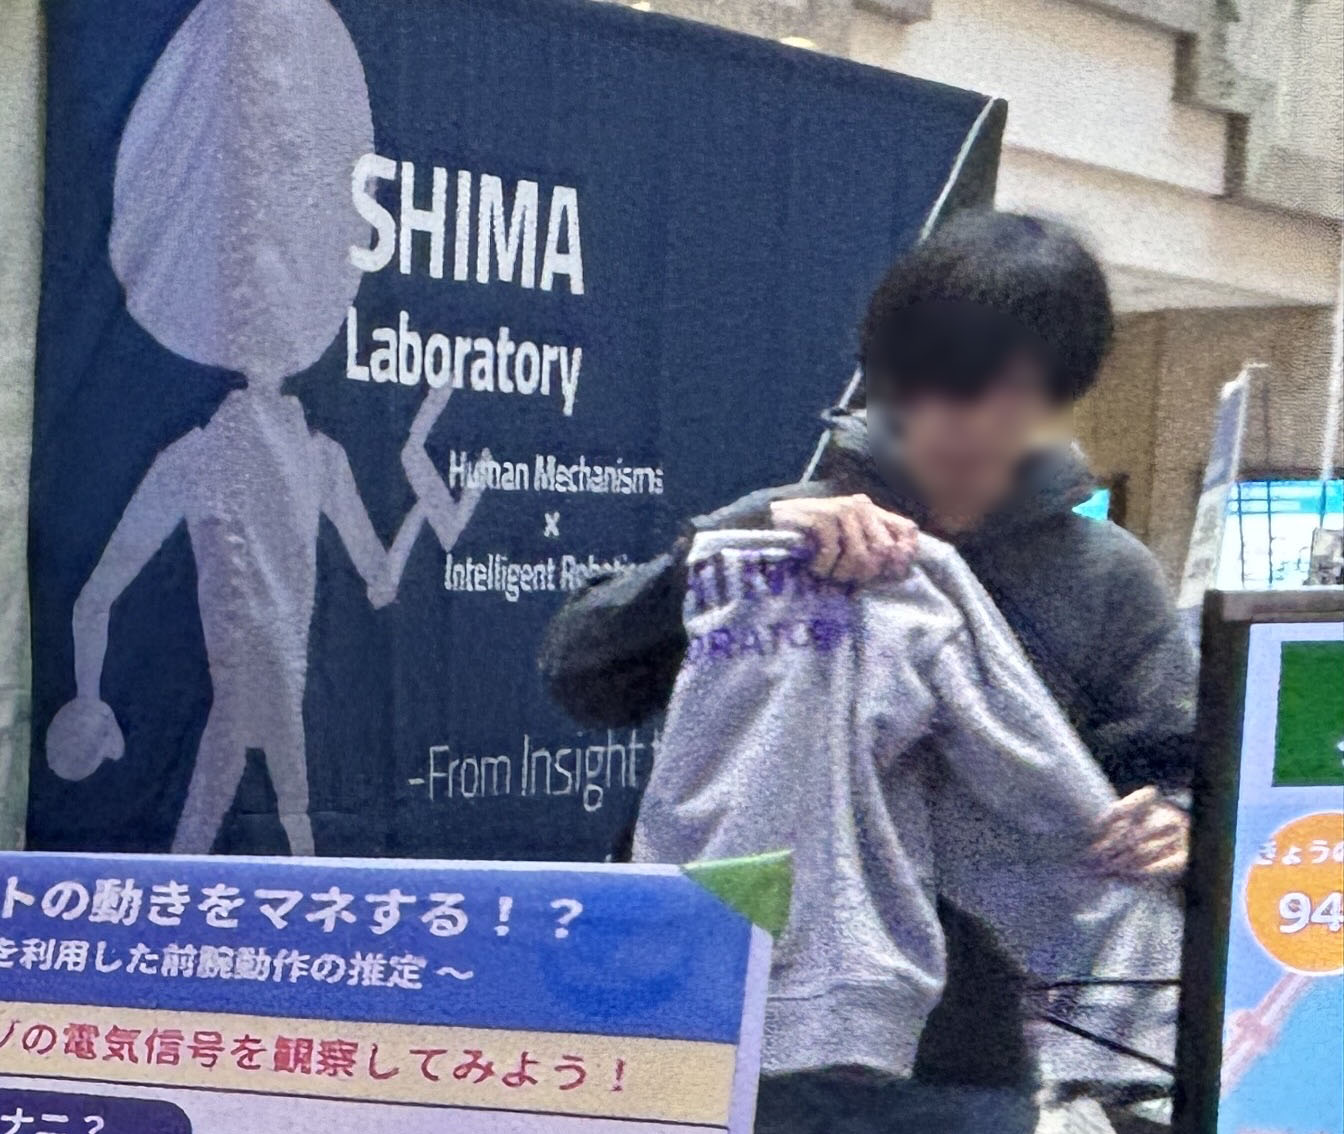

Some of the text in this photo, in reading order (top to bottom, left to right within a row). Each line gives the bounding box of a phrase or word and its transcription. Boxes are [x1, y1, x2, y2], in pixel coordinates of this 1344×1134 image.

[348, 152, 586, 295] SHIMA
[345, 305, 582, 416] Laboratory
[448, 448, 664, 494] Human Mechanisms
[444, 553, 559, 602] Intelligent
[520, 732, 647, 812] Insight
